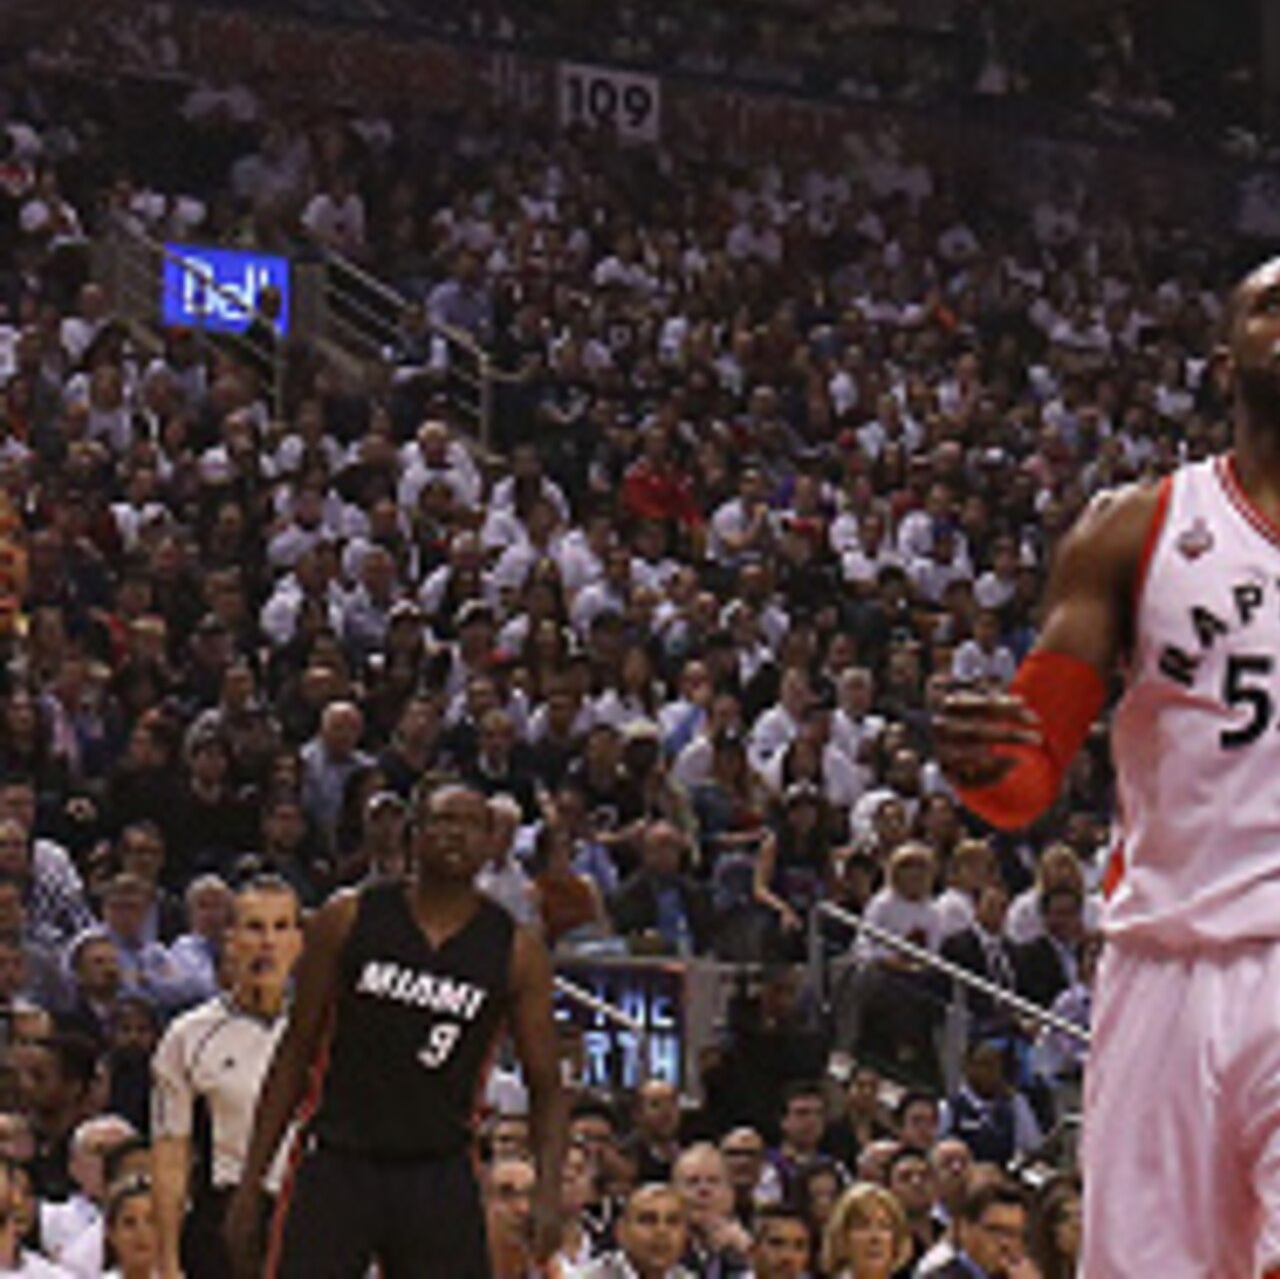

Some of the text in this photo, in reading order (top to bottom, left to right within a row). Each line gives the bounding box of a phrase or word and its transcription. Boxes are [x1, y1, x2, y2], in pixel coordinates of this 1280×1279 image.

[567, 77, 653, 127] 109
[356, 962, 487, 1020] MIAMI
[418, 1024, 461, 1068] 9
